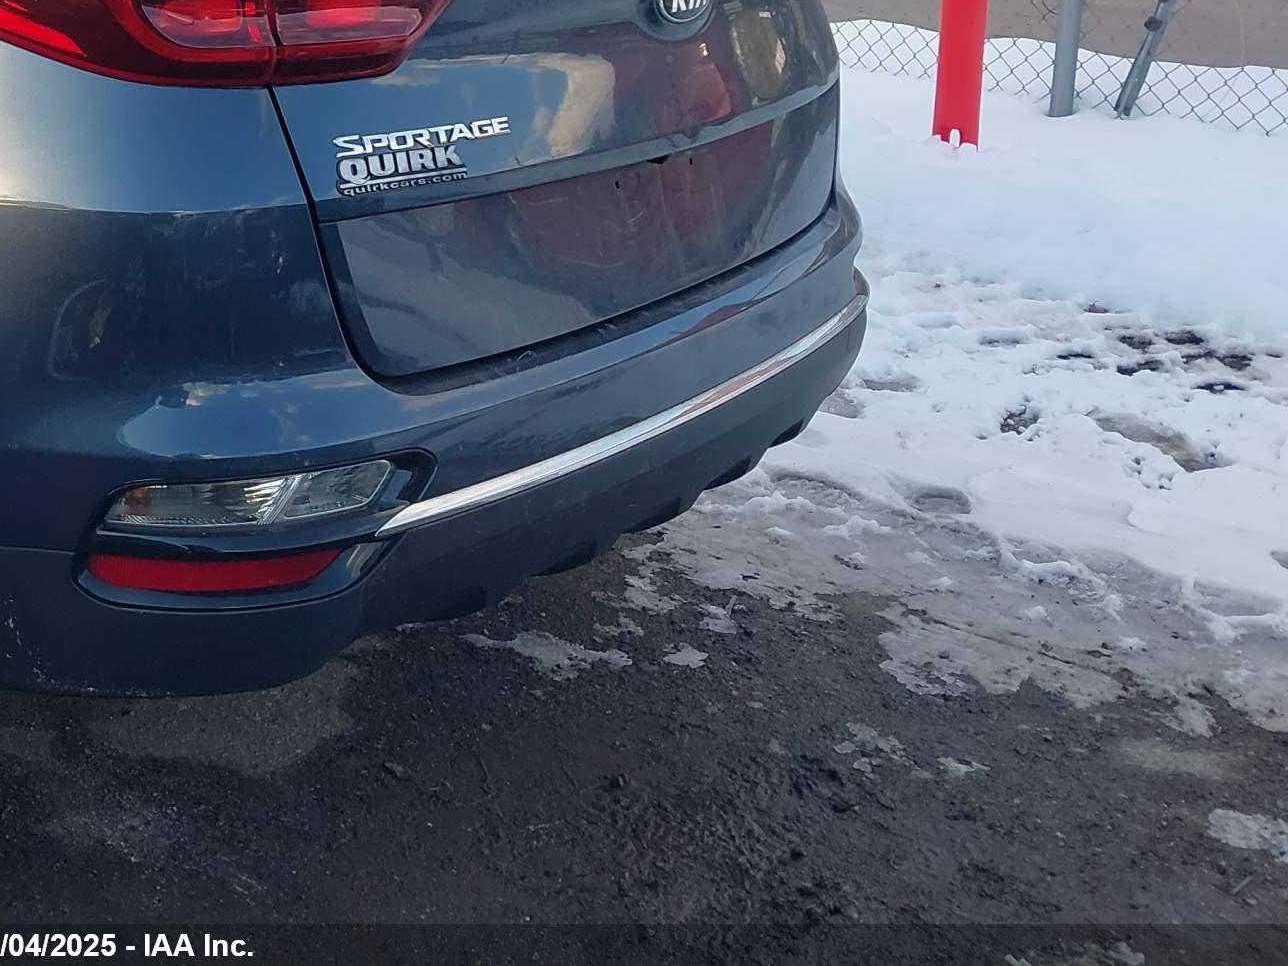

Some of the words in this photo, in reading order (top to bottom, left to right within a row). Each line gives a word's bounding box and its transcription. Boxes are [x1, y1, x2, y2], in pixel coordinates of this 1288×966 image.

[333, 116, 511, 158] SPORTAGE
[337, 144, 463, 184] QUIRK
[343, 170, 469, 197] quirkcars.com
